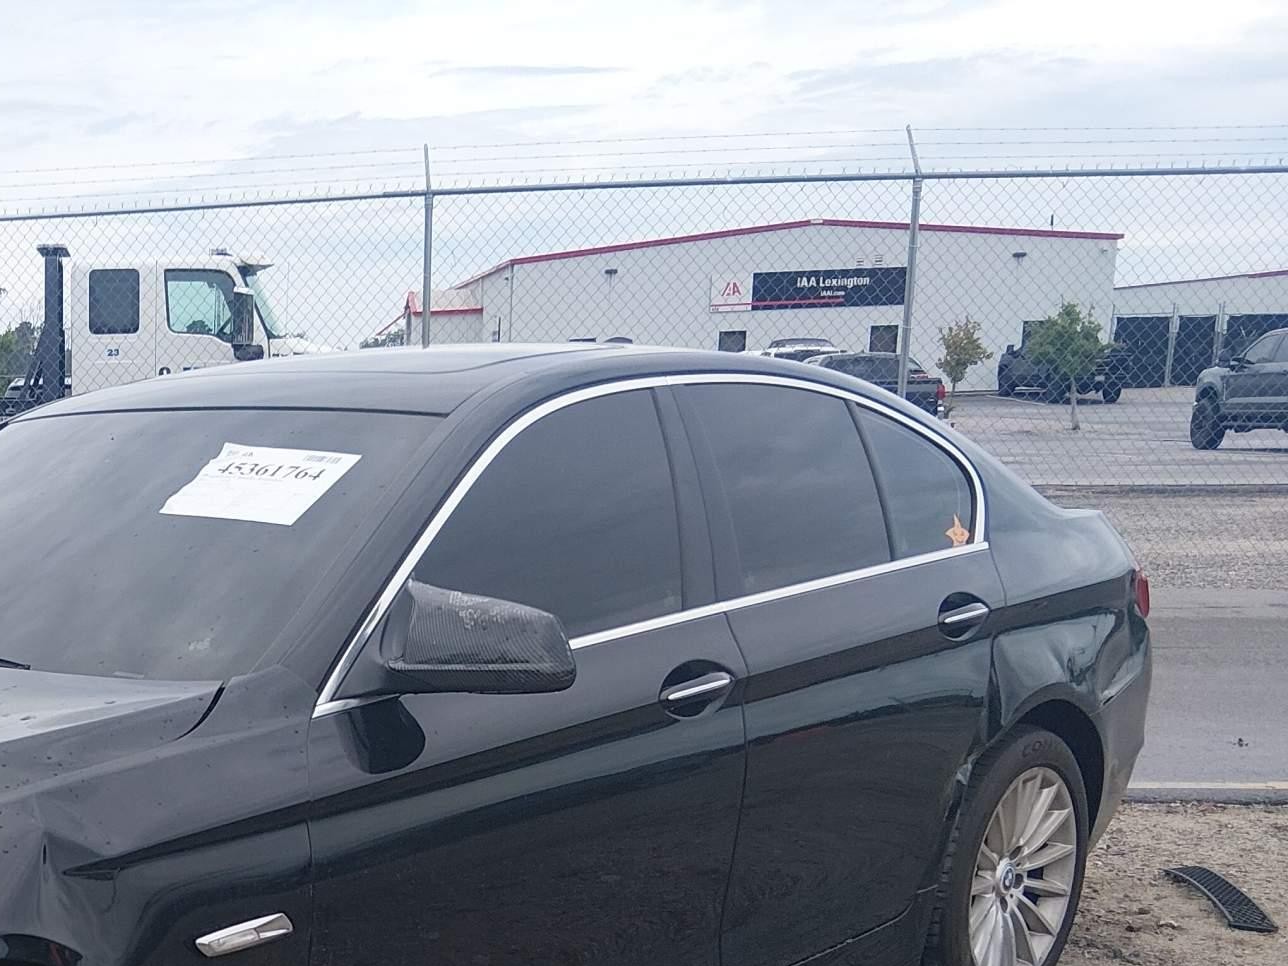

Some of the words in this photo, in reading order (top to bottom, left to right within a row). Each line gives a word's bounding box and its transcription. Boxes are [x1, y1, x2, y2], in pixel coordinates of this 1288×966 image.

[797, 277, 817, 288] IAA
[819, 276, 870, 288] Lexington
[107, 349, 120, 357] 23
[217, 462, 327, 481] 45361764
